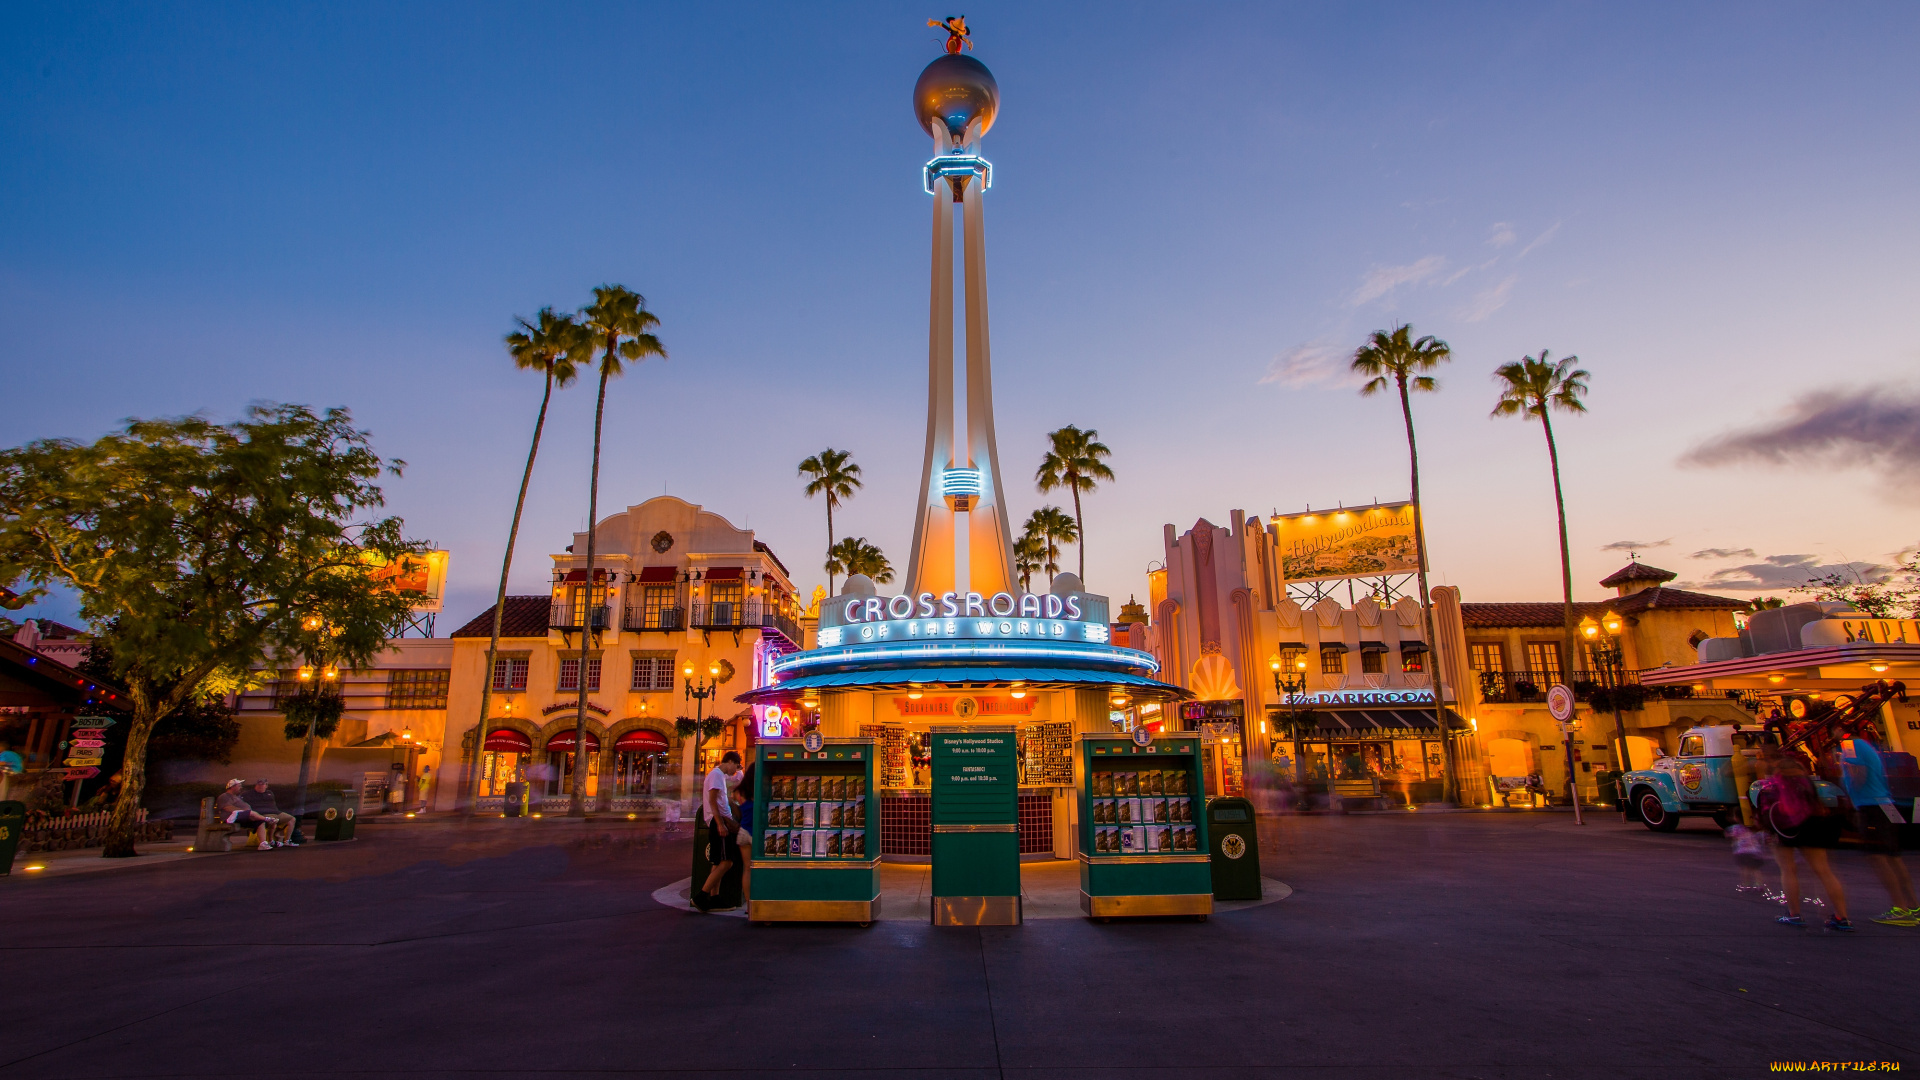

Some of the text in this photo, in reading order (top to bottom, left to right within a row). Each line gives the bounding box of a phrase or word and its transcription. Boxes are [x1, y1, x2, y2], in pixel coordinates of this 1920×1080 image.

[1286, 510, 1411, 559] Hollywoodland
[845, 592, 1082, 623] CROSSROADS
[861, 620, 1065, 639] OF THE WORLD
[1285, 692, 1436, 705] The DARKROOM
[904, 701, 949, 713] SOUVENIRS
[982, 700, 1029, 712] INFORMATION
[78, 718, 105, 726] BOSTON
[70, 768, 89, 776] ROME
